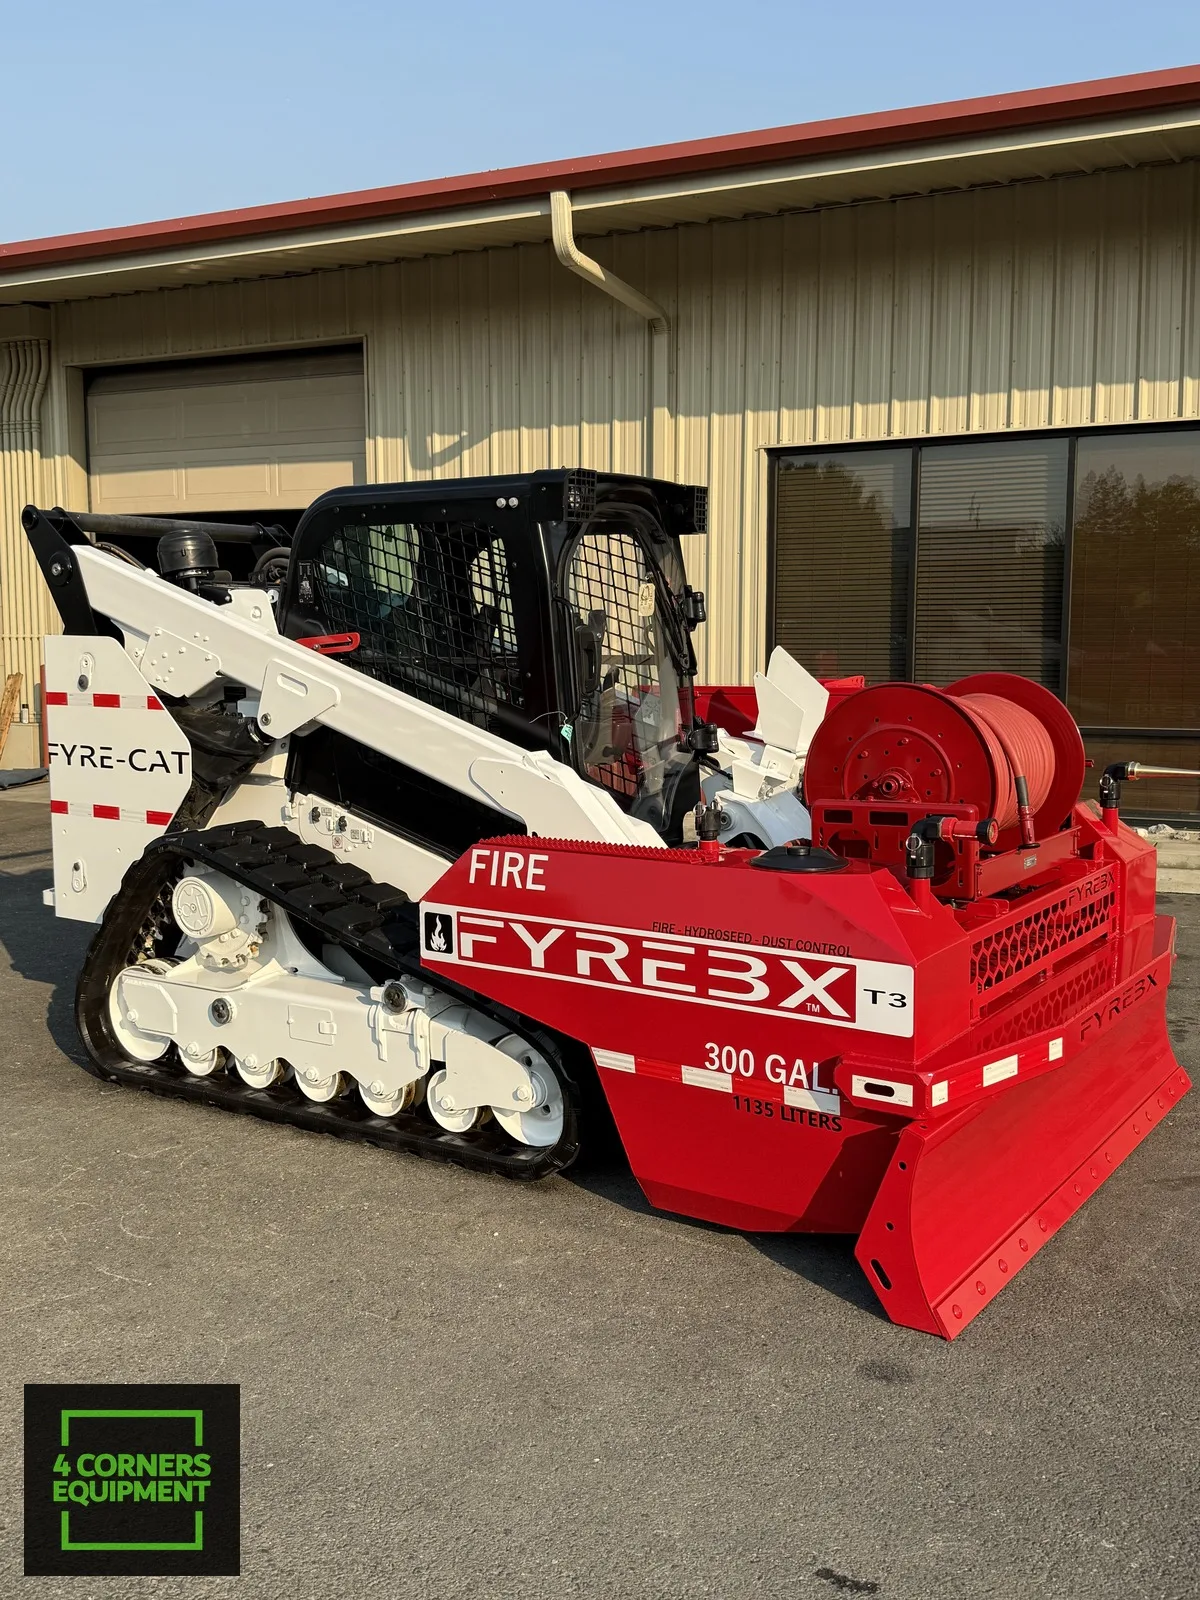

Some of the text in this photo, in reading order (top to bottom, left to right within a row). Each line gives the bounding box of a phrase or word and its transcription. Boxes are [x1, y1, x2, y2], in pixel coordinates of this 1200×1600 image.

[48, 743, 190, 775] FYRE-CAT
[469, 849, 549, 891] FIRE
[652, 921, 676, 935] FIRE
[684, 925, 753, 944] HYDROSEED
[762, 935, 793, 950] DUST
[795, 939, 853, 958] CONTROL
[863, 988, 908, 1009] T3
[704, 1042, 839, 1095] 300 GAL.
[732, 1095, 843, 1132] 1135 LITERS
